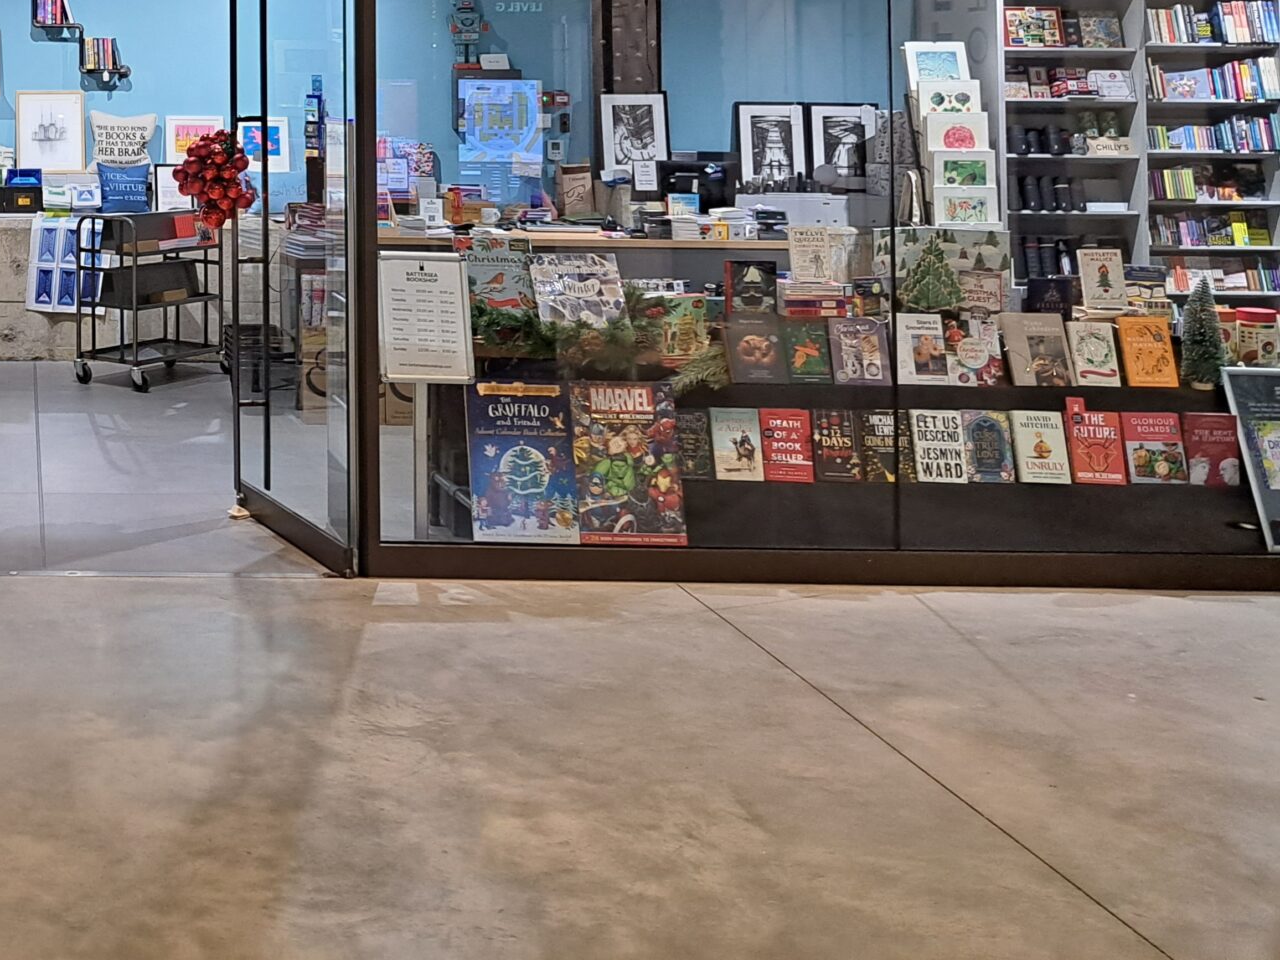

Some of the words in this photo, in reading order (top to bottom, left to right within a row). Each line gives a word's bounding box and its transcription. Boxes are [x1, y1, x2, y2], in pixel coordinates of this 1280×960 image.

[105, 132, 136, 140] BOOKS
[98, 147, 116, 156] HER
[102, 172, 128, 180] VICES
[467, 253, 522, 264] Christmas
[590, 388, 649, 411] MARVEL
[488, 404, 550, 417] GRUFFALO
[513, 418, 540, 426] Friends
[769, 420, 801, 428] DEATH
[869, 415, 895, 425] MICHA
[916, 415, 939, 429] LET
[942, 416, 959, 430] US
[1083, 413, 1105, 425] THE
[831, 429, 840, 437] 12
[917, 430, 960, 443] DESCEND
[1074, 426, 1117, 439] FUTURE
[772, 442, 801, 450] BOOK
[822, 437, 852, 447] DAYS
[865, 436, 885, 446] GOING
[920, 448, 961, 461] JESMYN
[976, 450, 1001, 459] LOVE
[921, 462, 963, 478] WARD
[1025, 461, 1065, 471] UNRULY
